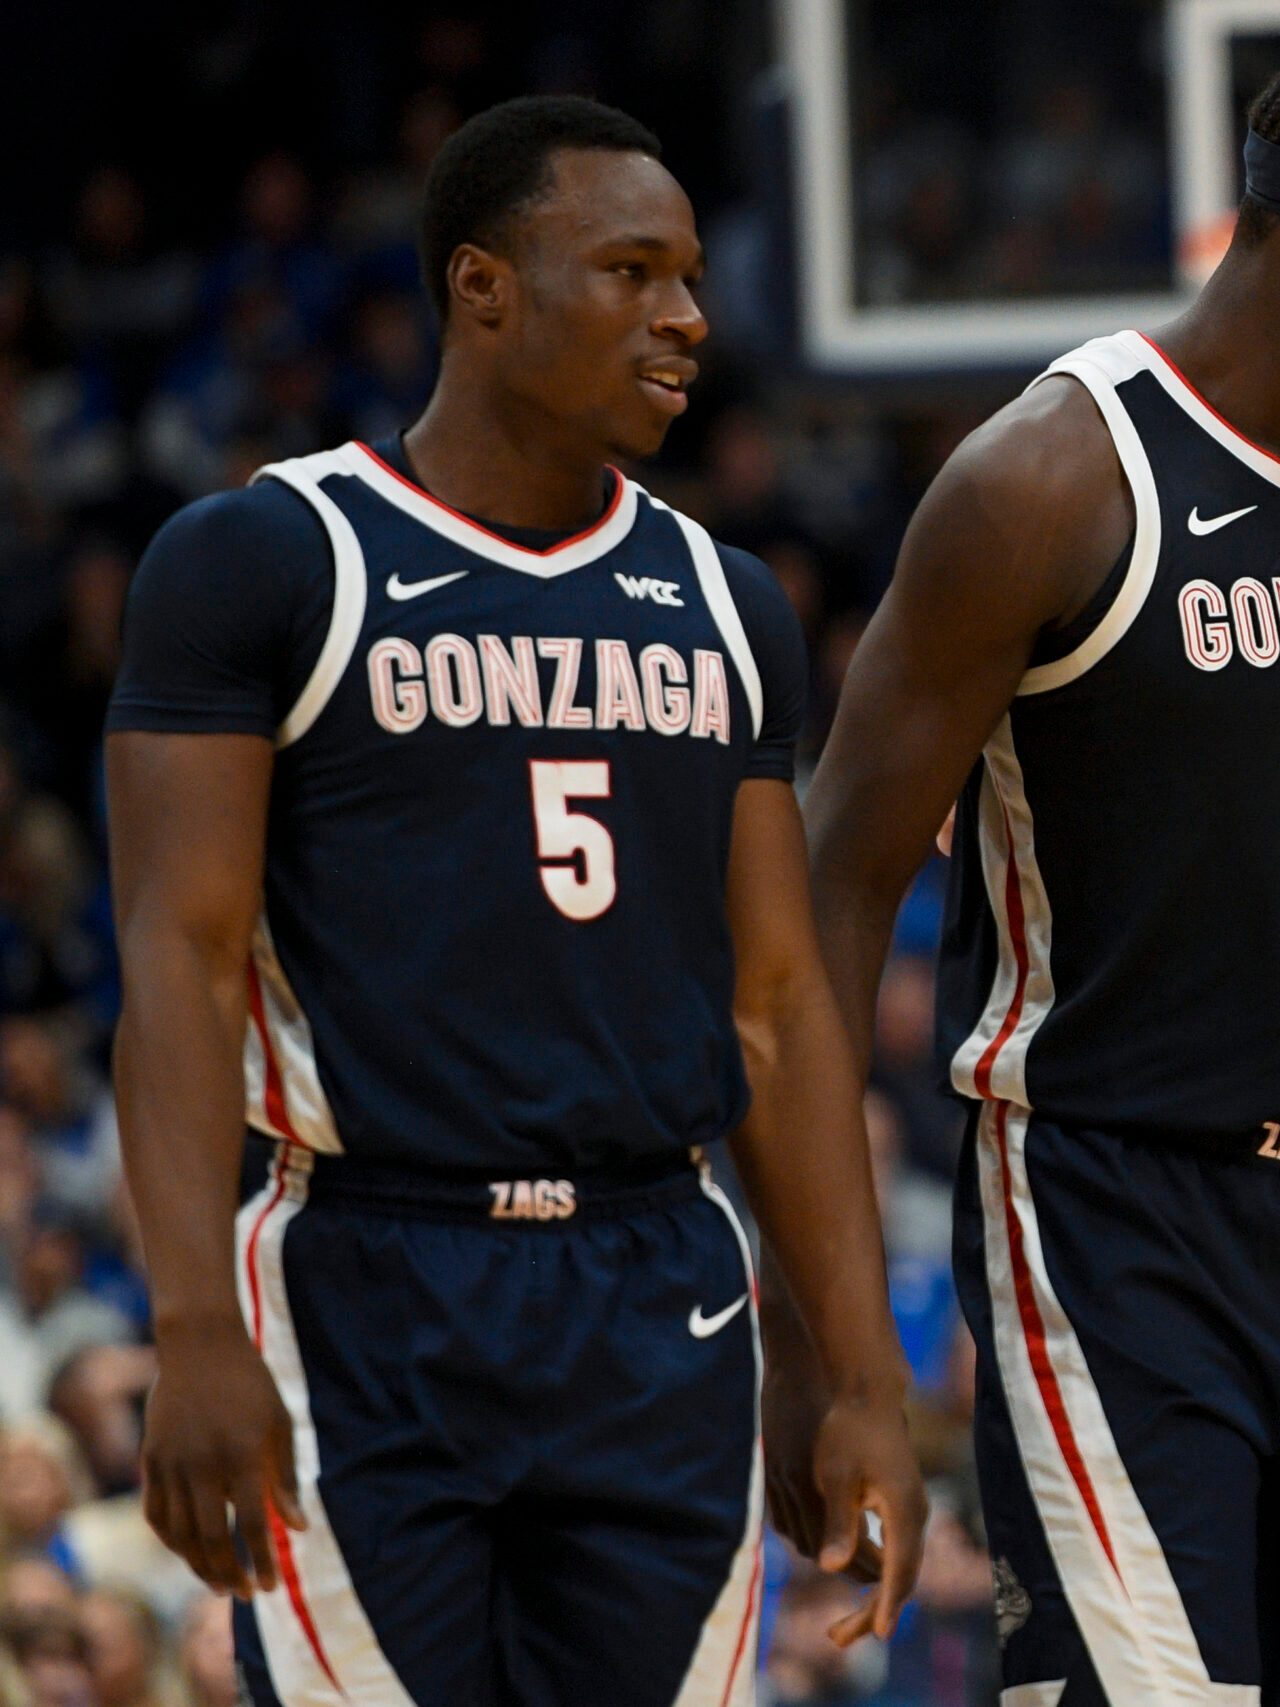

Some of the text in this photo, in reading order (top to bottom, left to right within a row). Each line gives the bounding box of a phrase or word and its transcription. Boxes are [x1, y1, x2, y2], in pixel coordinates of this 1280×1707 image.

[614, 572, 686, 607] WCC
[366, 632, 731, 745] GONZAGA
[529, 758, 617, 922] 5
[488, 1178, 577, 1220] ZAGS
